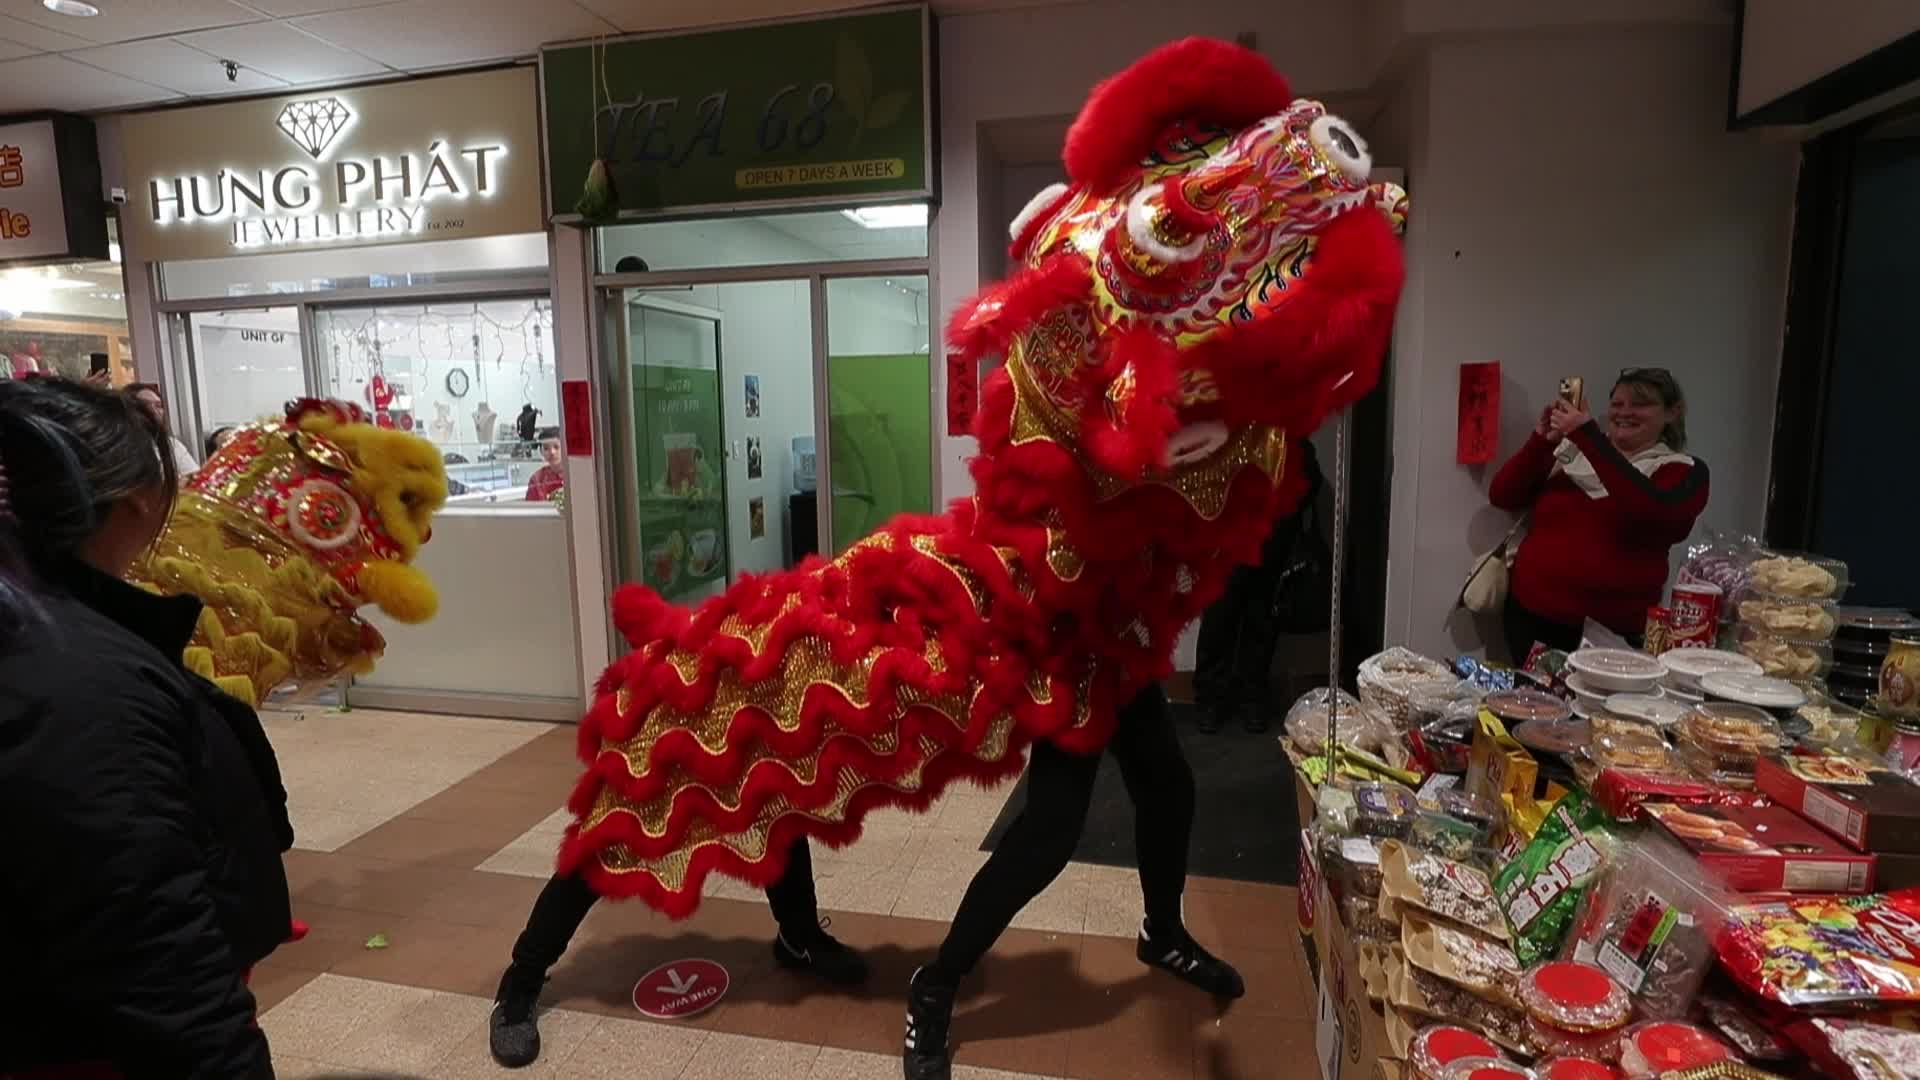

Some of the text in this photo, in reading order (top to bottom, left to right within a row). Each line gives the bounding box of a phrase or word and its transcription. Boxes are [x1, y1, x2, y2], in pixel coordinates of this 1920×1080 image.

[597, 82, 834, 168] TEA 68
[336, 141, 500, 204] PHÁT
[744, 161, 894, 185] OPEN 7 DAYS A WEEK
[228, 204, 420, 246] JEWELLERY
[241, 329, 268, 342] UNIT
[660, 986, 717, 1014] ONE WAY
